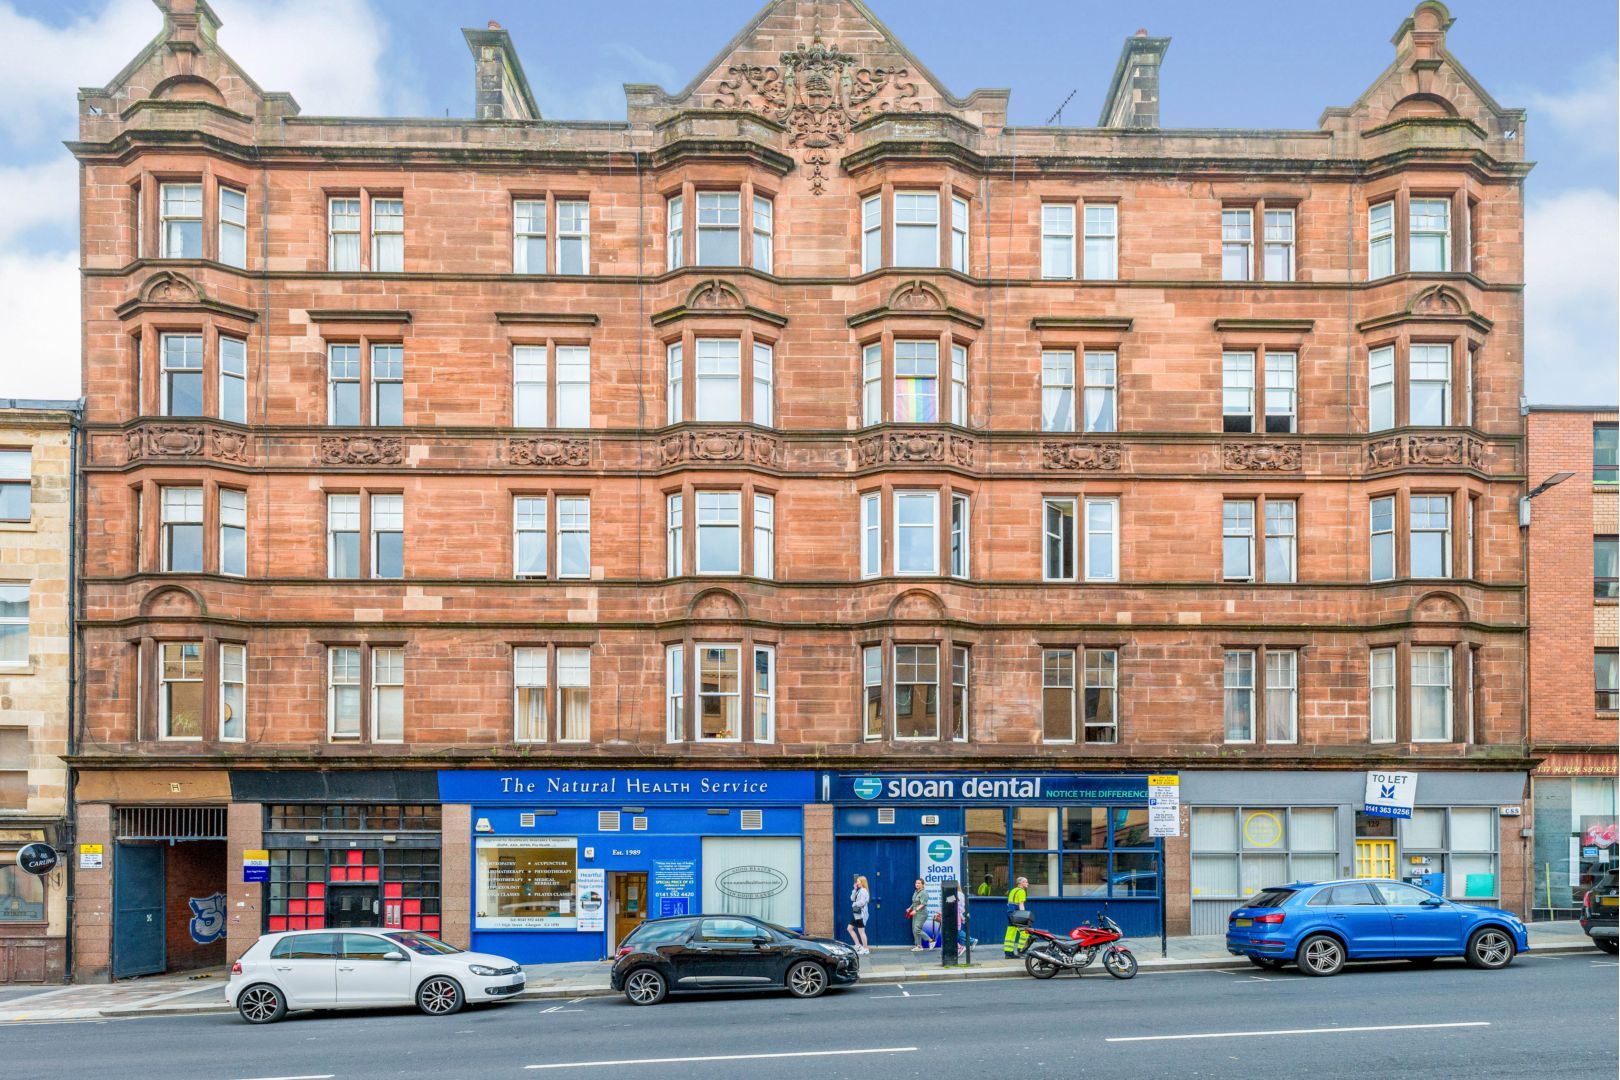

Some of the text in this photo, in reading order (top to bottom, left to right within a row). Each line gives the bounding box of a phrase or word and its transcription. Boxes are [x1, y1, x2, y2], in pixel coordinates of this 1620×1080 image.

[1372, 774, 1408, 784] TO LET
[500, 777, 768, 793] The Natural HEALTH Service
[888, 777, 1041, 798] sloan dental
[1046, 790, 1078, 798] NOTICE
[1080, 790, 1097, 798] THE
[1365, 805, 1410, 816] 0141 363 0256
[28, 857, 55, 868] CARLING
[927, 864, 953, 873] sloan
[925, 873, 956, 883] dental
